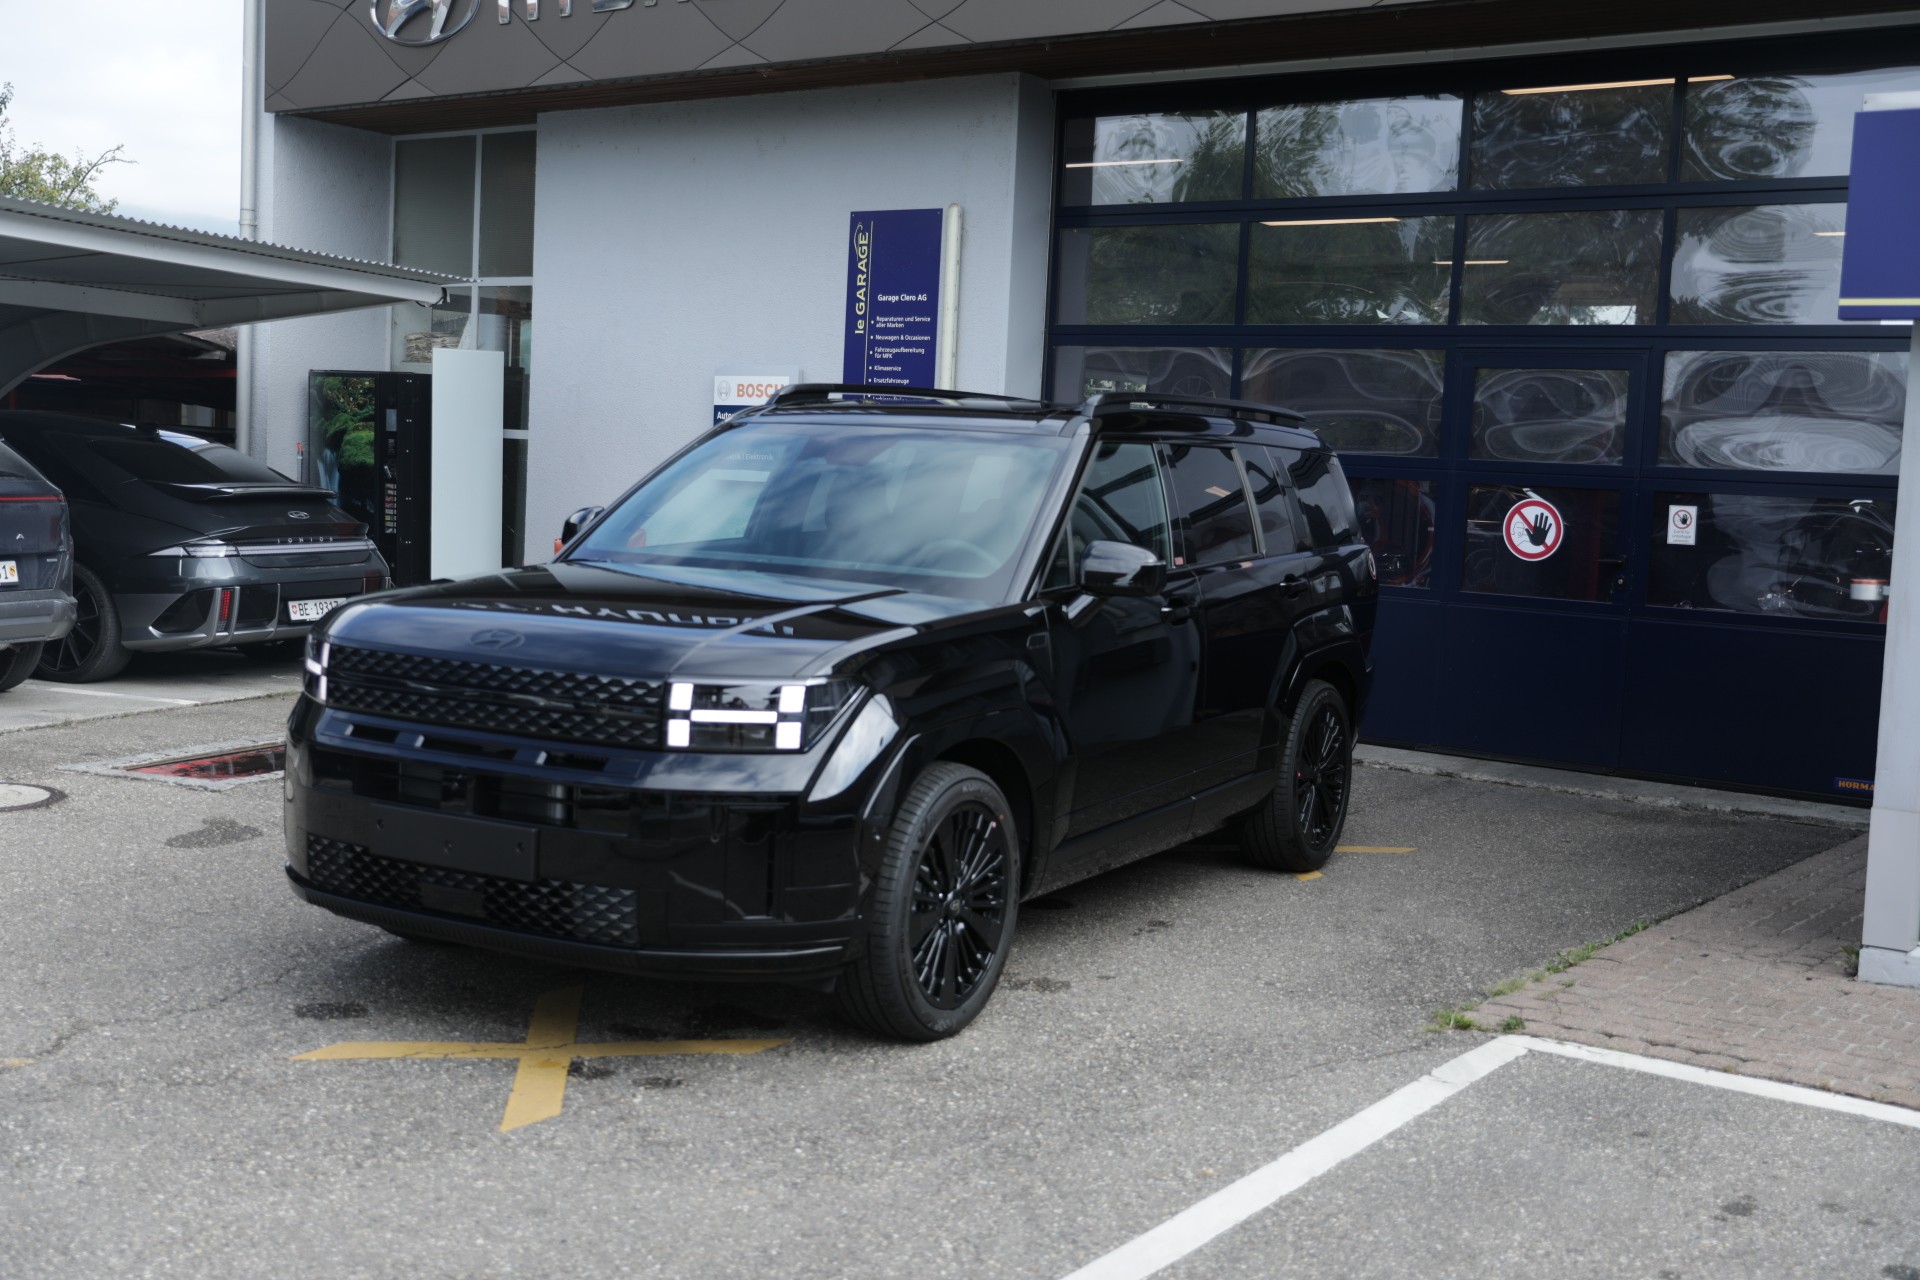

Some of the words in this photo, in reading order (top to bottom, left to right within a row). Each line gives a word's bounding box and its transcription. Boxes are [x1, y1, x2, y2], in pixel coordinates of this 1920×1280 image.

[856, 231, 869, 316] GARAGE
[877, 294, 899, 303] Garage
[900, 293, 917, 302] Clero
[917, 294, 928, 302] AG
[855, 320, 865, 334] le
[874, 346, 925, 354] Fahrzeugaufbereitung
[873, 377, 909, 385] Ersatzfahrzeuge
